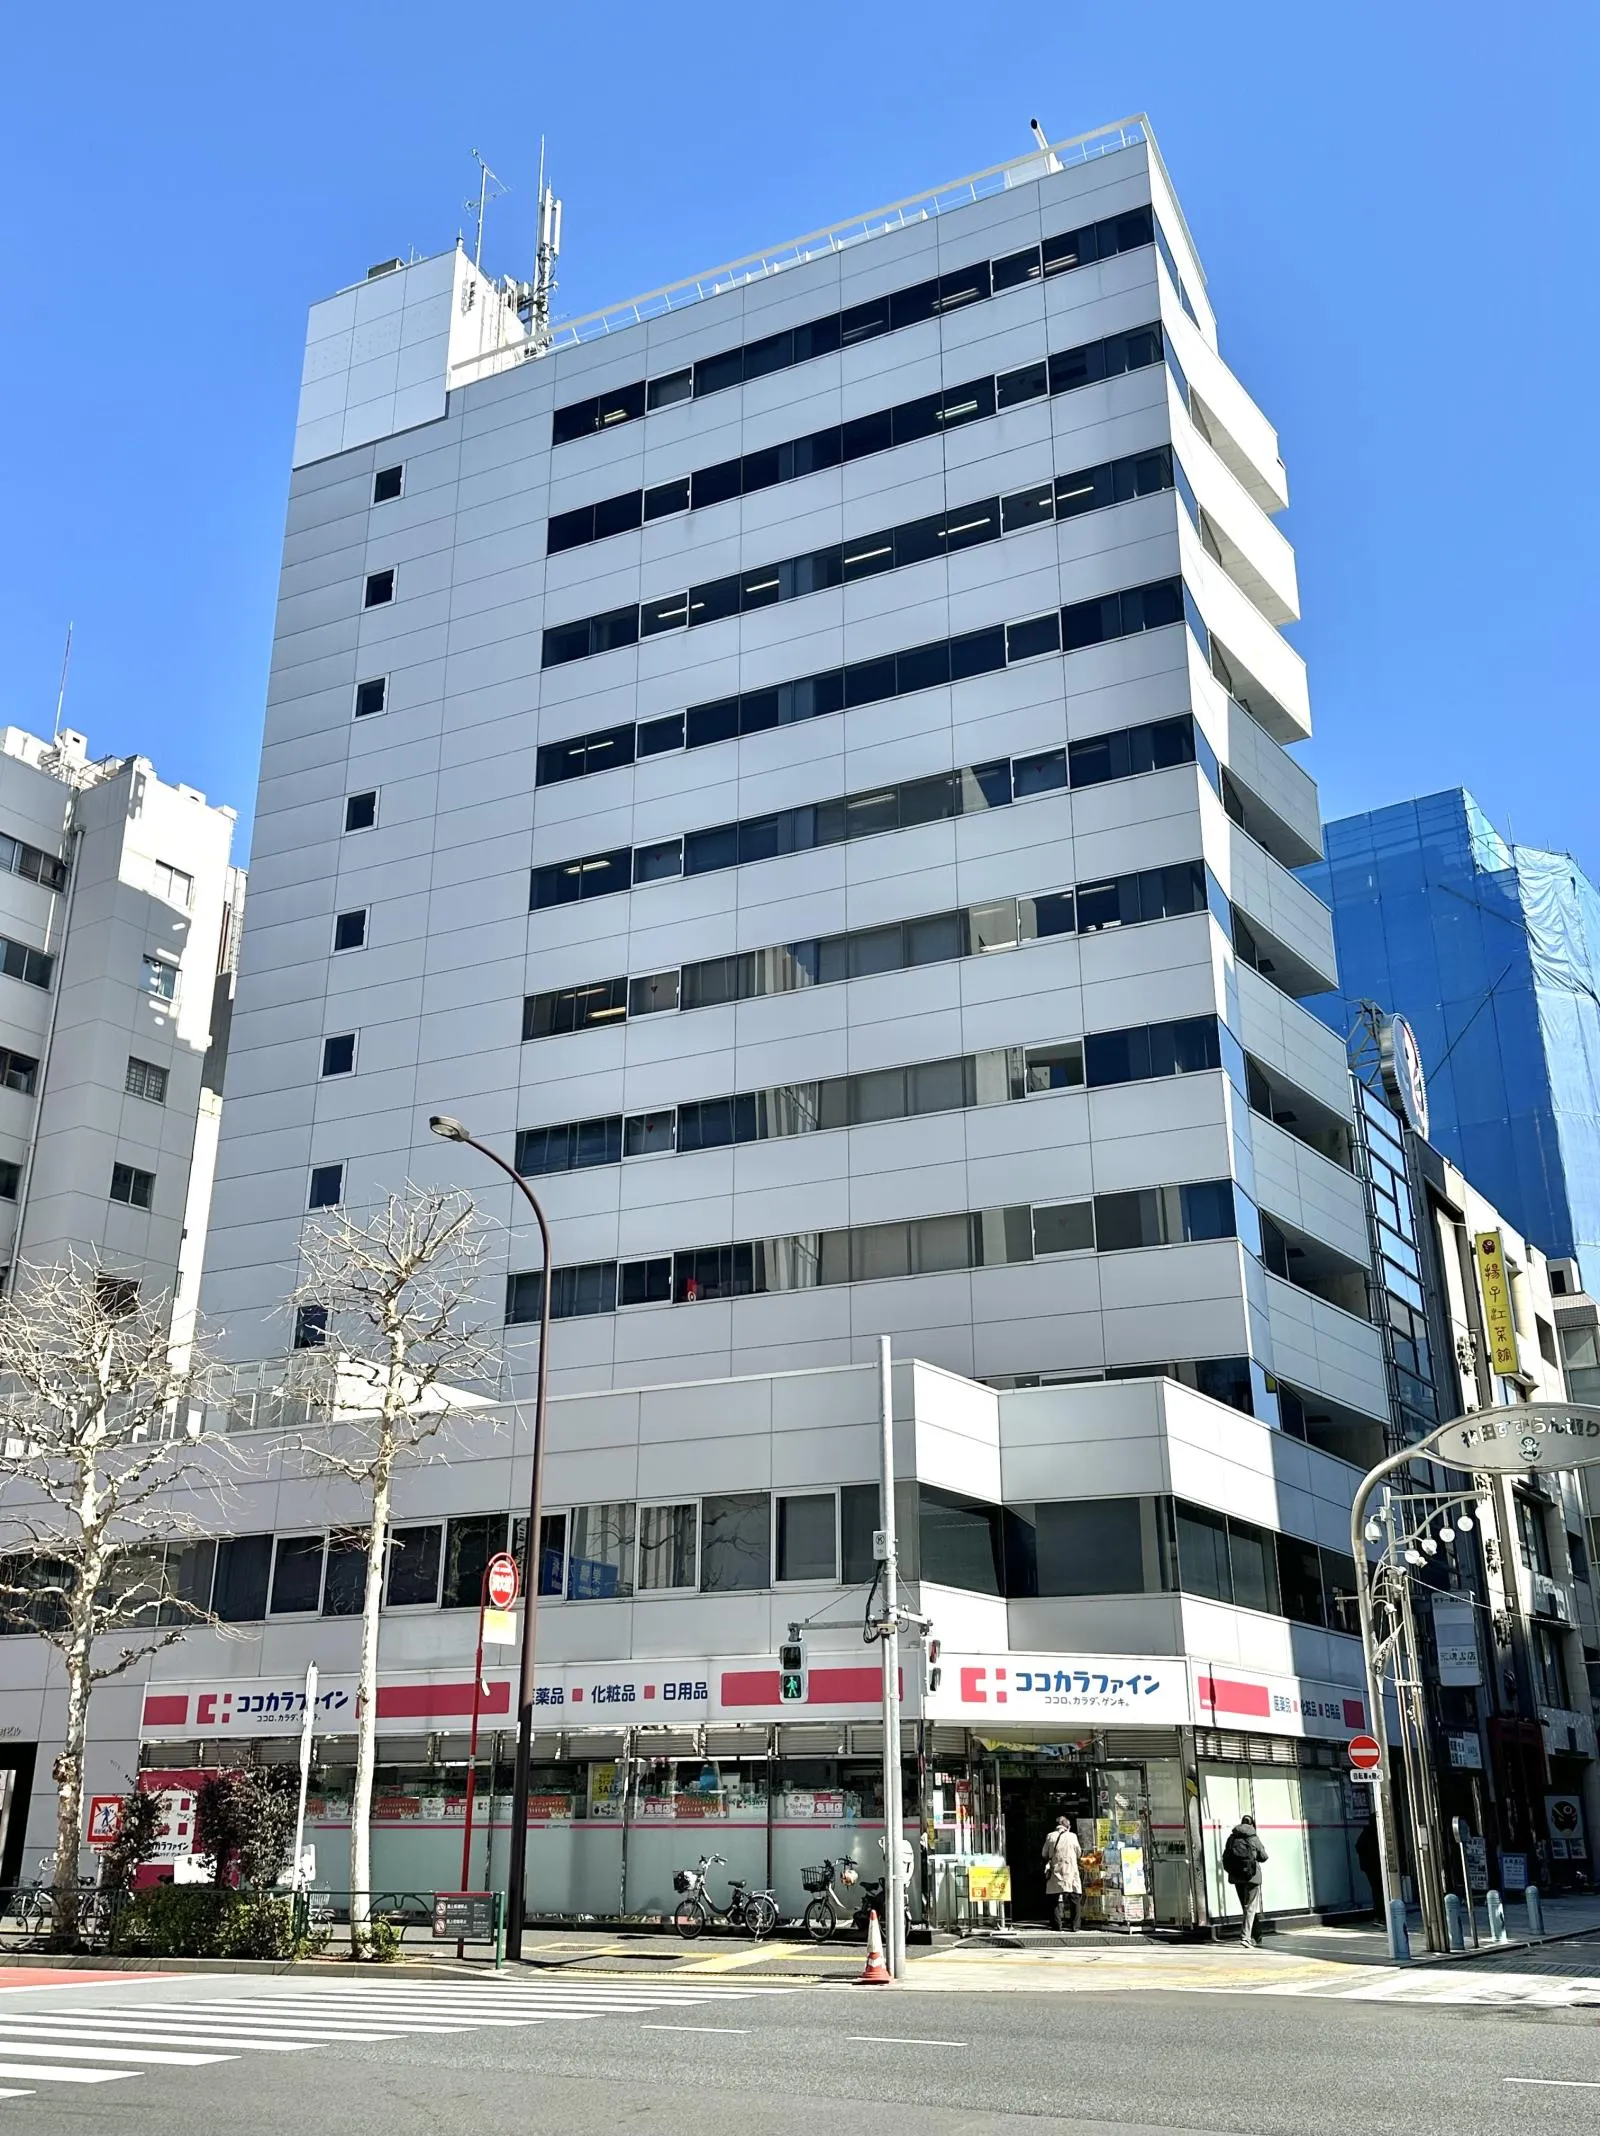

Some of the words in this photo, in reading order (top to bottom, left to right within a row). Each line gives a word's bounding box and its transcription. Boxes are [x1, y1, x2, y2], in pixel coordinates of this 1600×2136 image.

[532, 1687, 564, 1706] 薬品
[591, 1684, 636, 1704] 化粧品
[663, 1682, 708, 1701] 日用品
[1015, 1670, 1160, 1695] ココカラファイン
[1044, 1696, 1130, 1707] ココロ、カラダ、ゲンキ。
